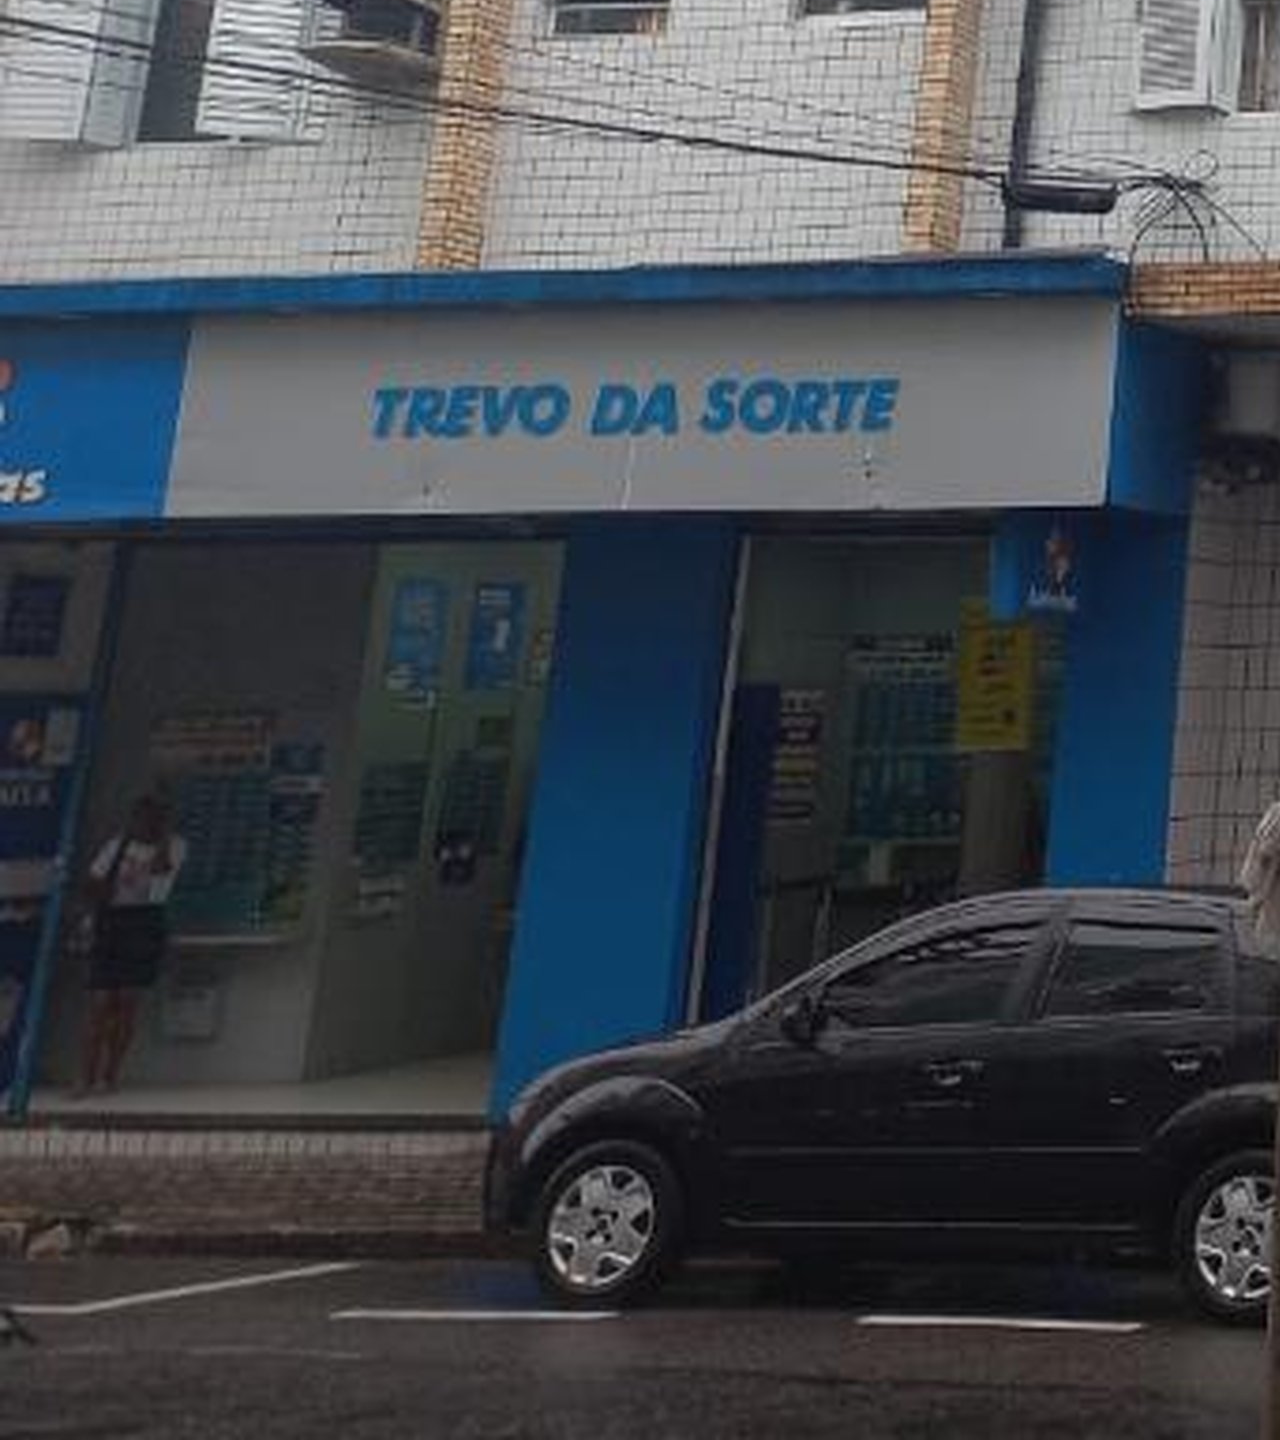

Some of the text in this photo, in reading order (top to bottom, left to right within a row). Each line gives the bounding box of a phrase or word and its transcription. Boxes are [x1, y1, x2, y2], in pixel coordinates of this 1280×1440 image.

[373, 379, 898, 439] TREVO DA SORTE
